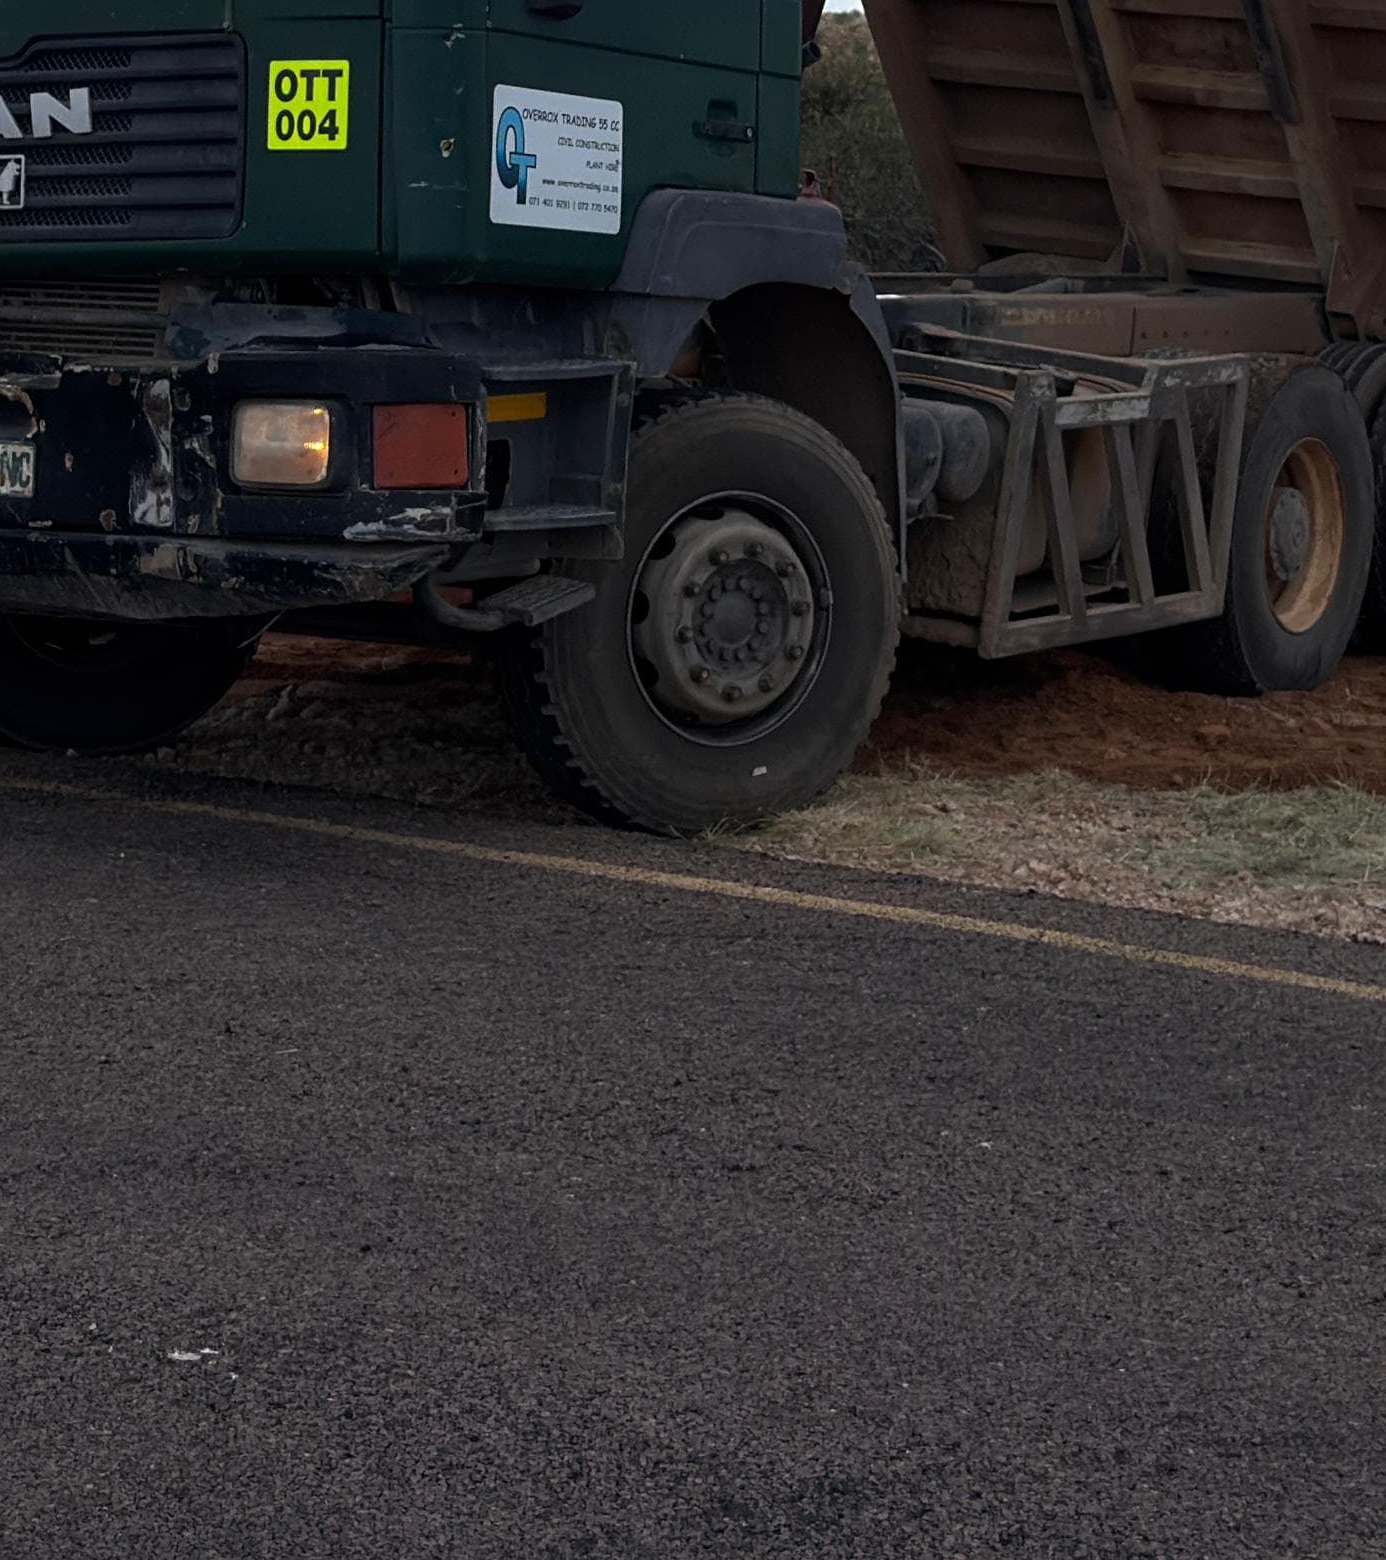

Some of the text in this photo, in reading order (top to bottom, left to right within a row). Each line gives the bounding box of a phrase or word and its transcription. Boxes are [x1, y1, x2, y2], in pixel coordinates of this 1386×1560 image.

[274, 68, 344, 103] OTT
[275, 108, 340, 142] 004
[522, 108, 559, 125] OVERROX
[562, 113, 597, 129] TRADING
[599, 118, 609, 131] 55
